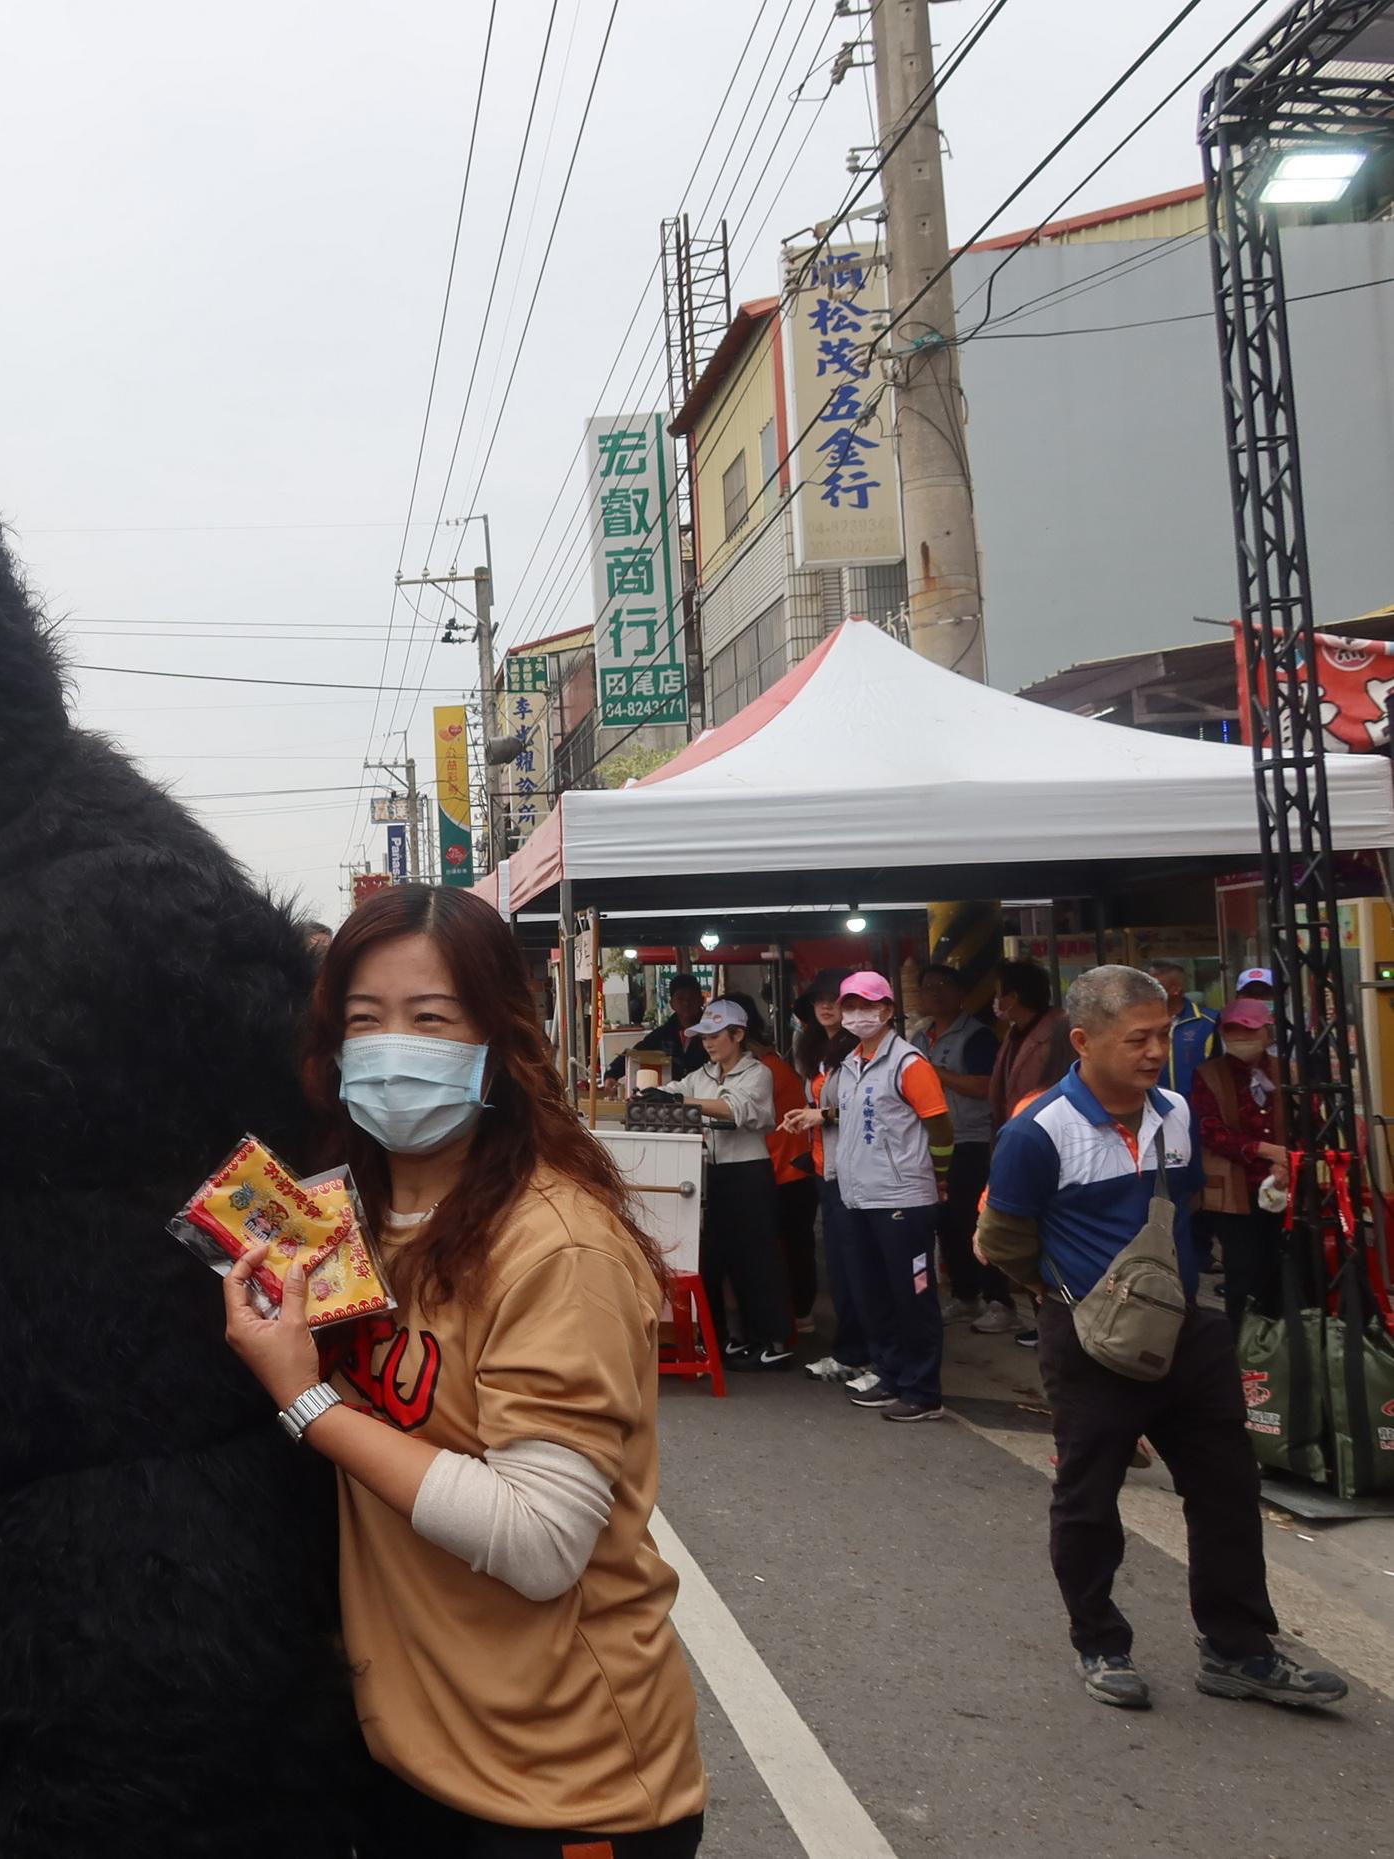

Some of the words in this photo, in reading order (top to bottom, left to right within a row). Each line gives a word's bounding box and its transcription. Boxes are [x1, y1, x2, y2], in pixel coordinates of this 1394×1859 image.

[808, 251, 883, 511] 順松茂五金行
[597, 430, 659, 658] 宏叡商行
[606, 669, 682, 697] 田尾店
[606, 698, 684, 719] 04-8243171
